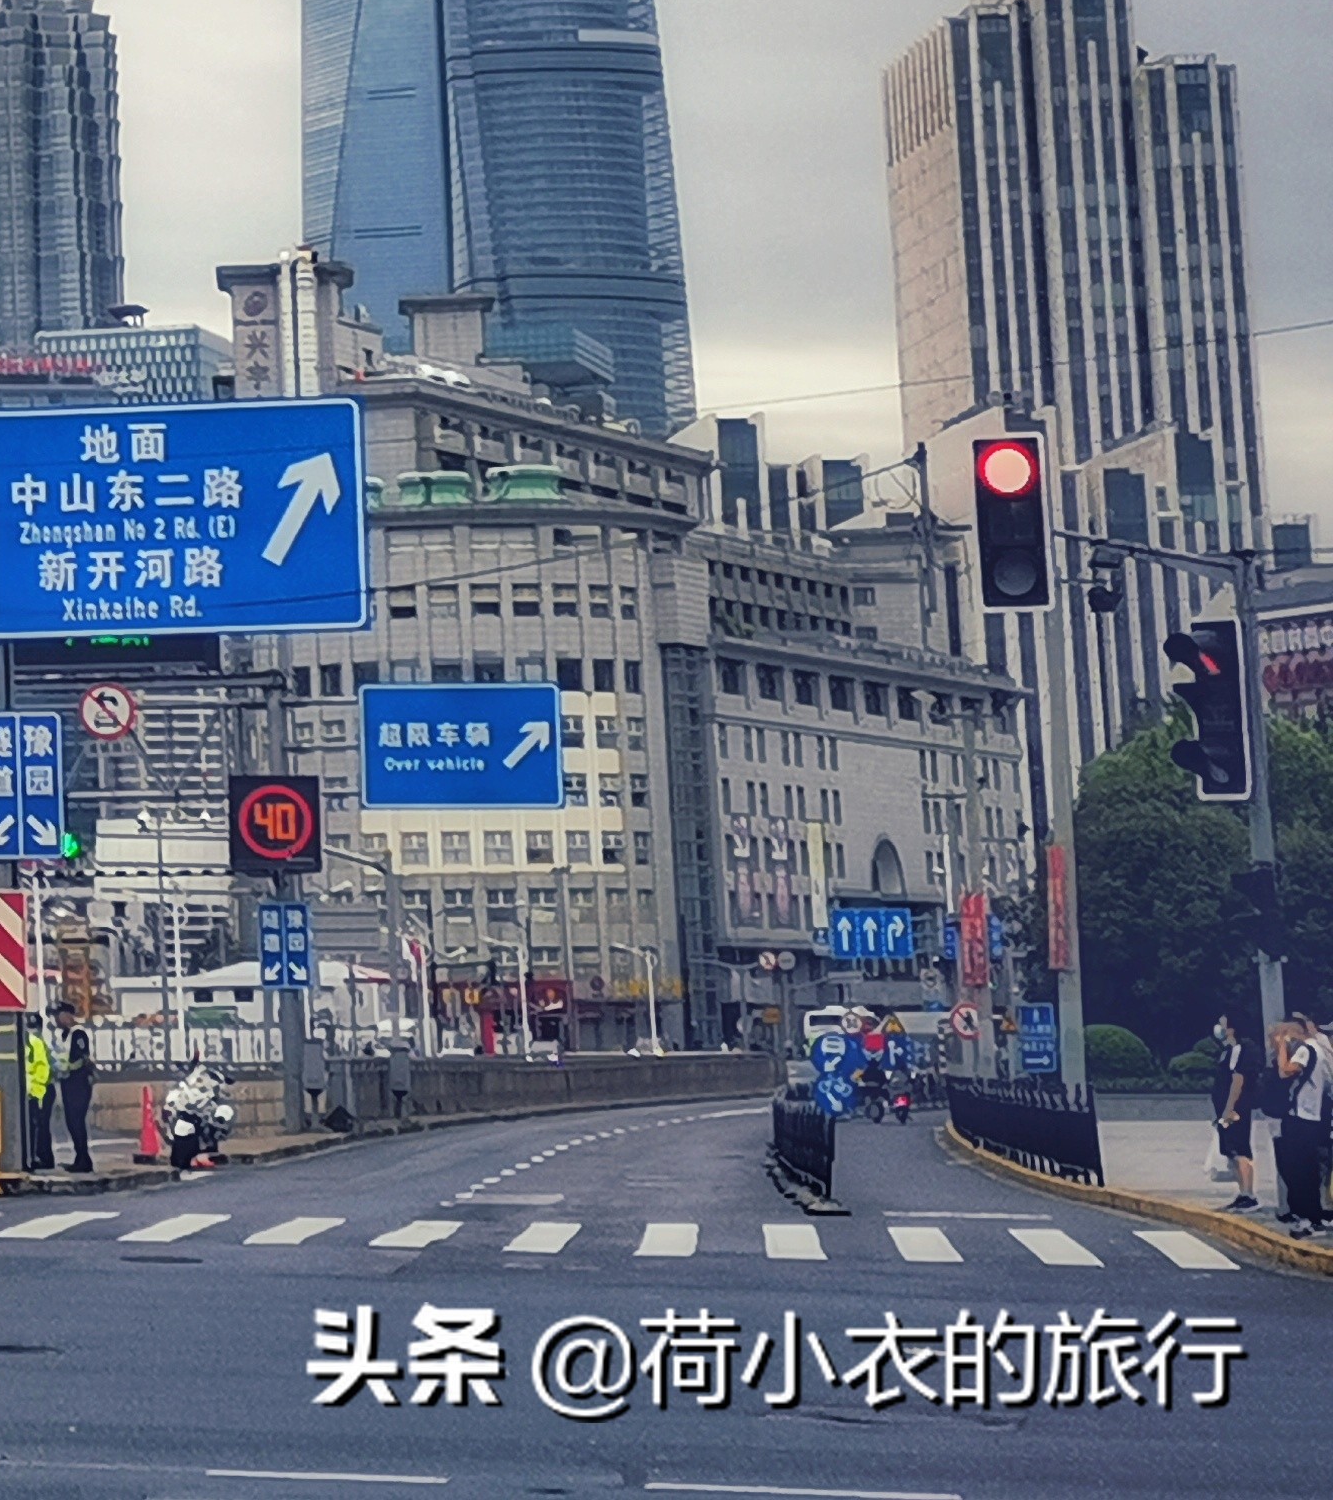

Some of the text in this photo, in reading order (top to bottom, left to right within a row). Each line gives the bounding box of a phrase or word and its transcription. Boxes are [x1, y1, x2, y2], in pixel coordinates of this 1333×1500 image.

[79, 423, 167, 464] 地面
[11, 466, 243, 516] 中山东二路
[19, 521, 116, 549] Zhongshan
[154, 517, 166, 540] 2
[208, 515, 236, 539] (E)
[38, 546, 224, 592] 新开河路
[63, 594, 203, 621] Xinkaihe Rd.
[23, 725, 54, 797] 豫园
[384, 755, 486, 772] Over vehicle
[254, 803, 296, 841] 40
